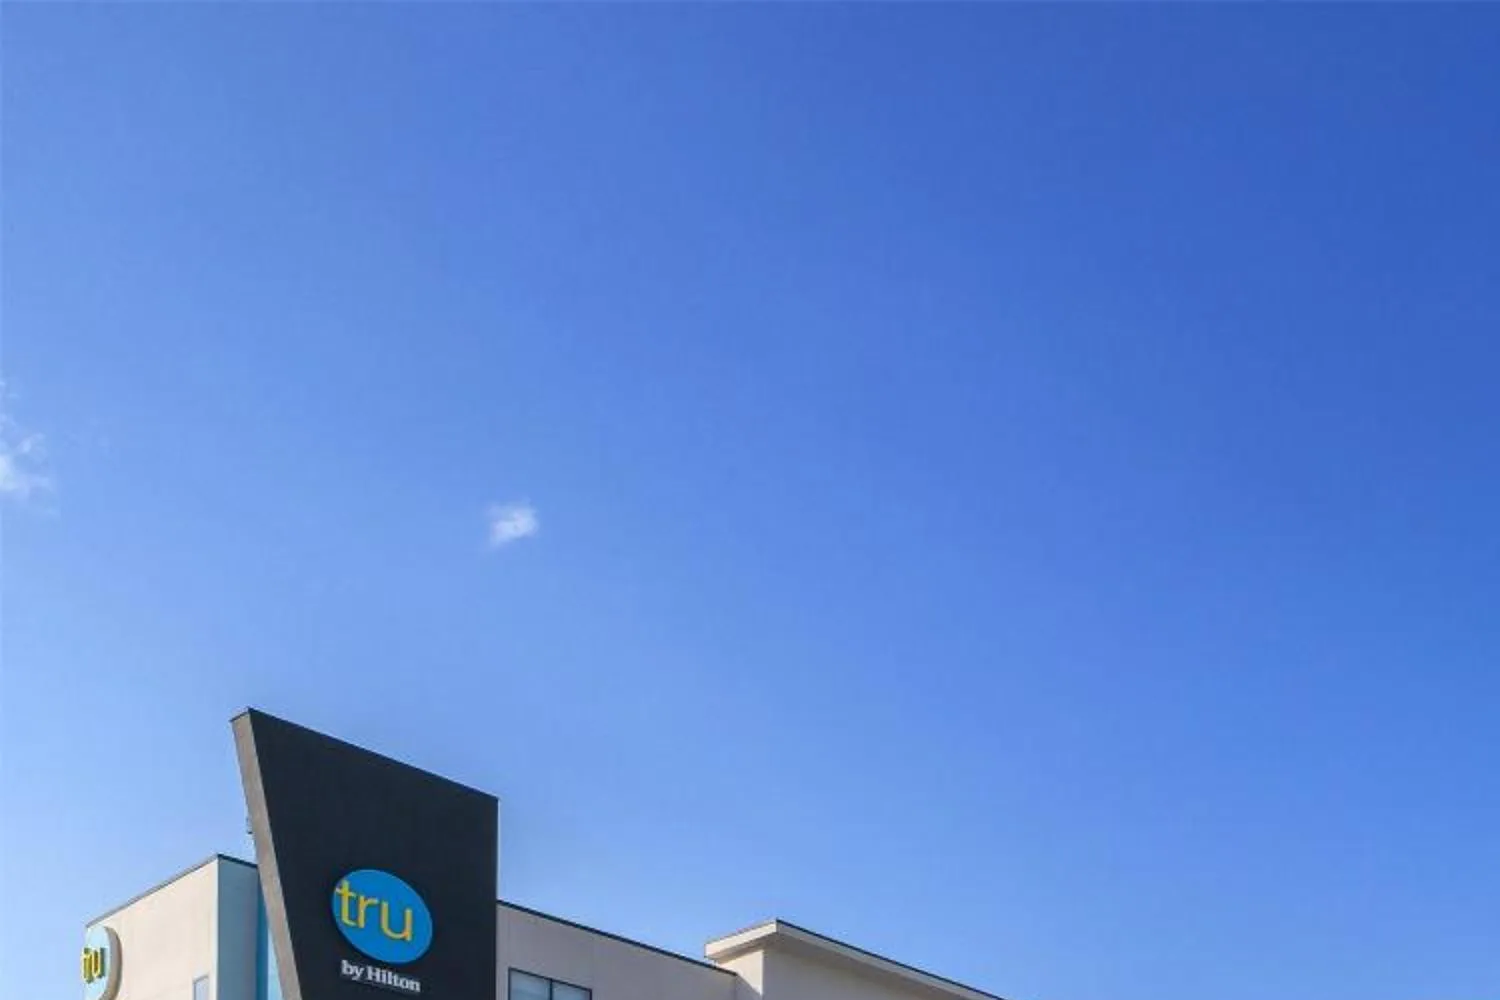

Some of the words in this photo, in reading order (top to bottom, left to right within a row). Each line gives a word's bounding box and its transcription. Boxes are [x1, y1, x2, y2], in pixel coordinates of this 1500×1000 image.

[335, 879, 413, 942] tru
[341, 959, 364, 981] by
[366, 965, 421, 993] Hilton
